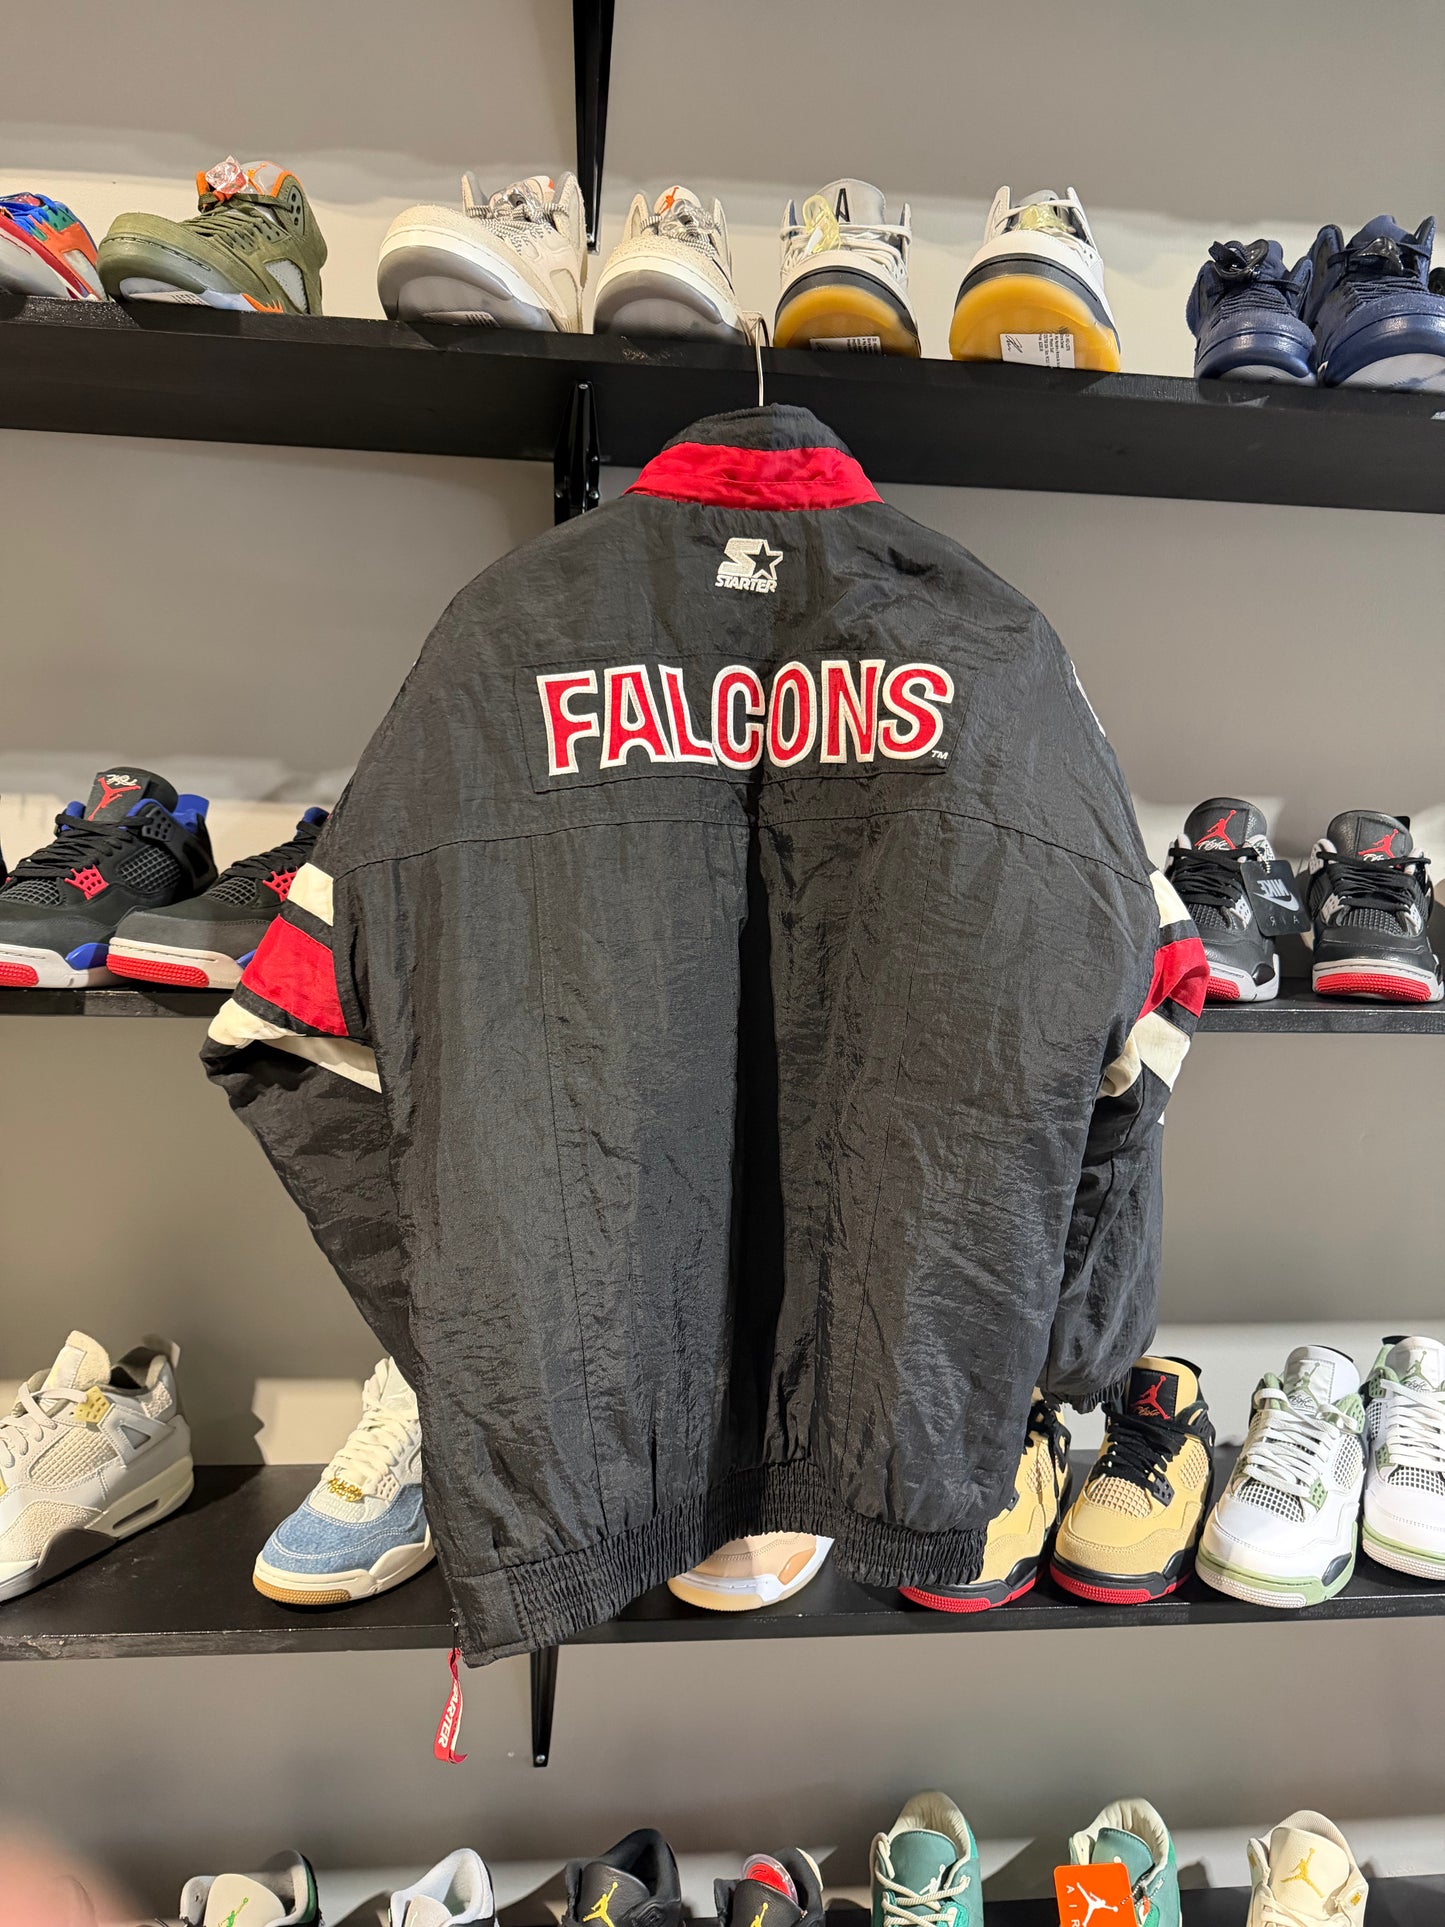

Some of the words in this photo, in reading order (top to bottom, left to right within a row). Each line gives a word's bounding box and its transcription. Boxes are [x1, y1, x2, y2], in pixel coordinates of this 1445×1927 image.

[714, 574, 778, 594] STARTER
[536, 659, 954, 776] FALCONS
[931, 749, 949, 760] TM
